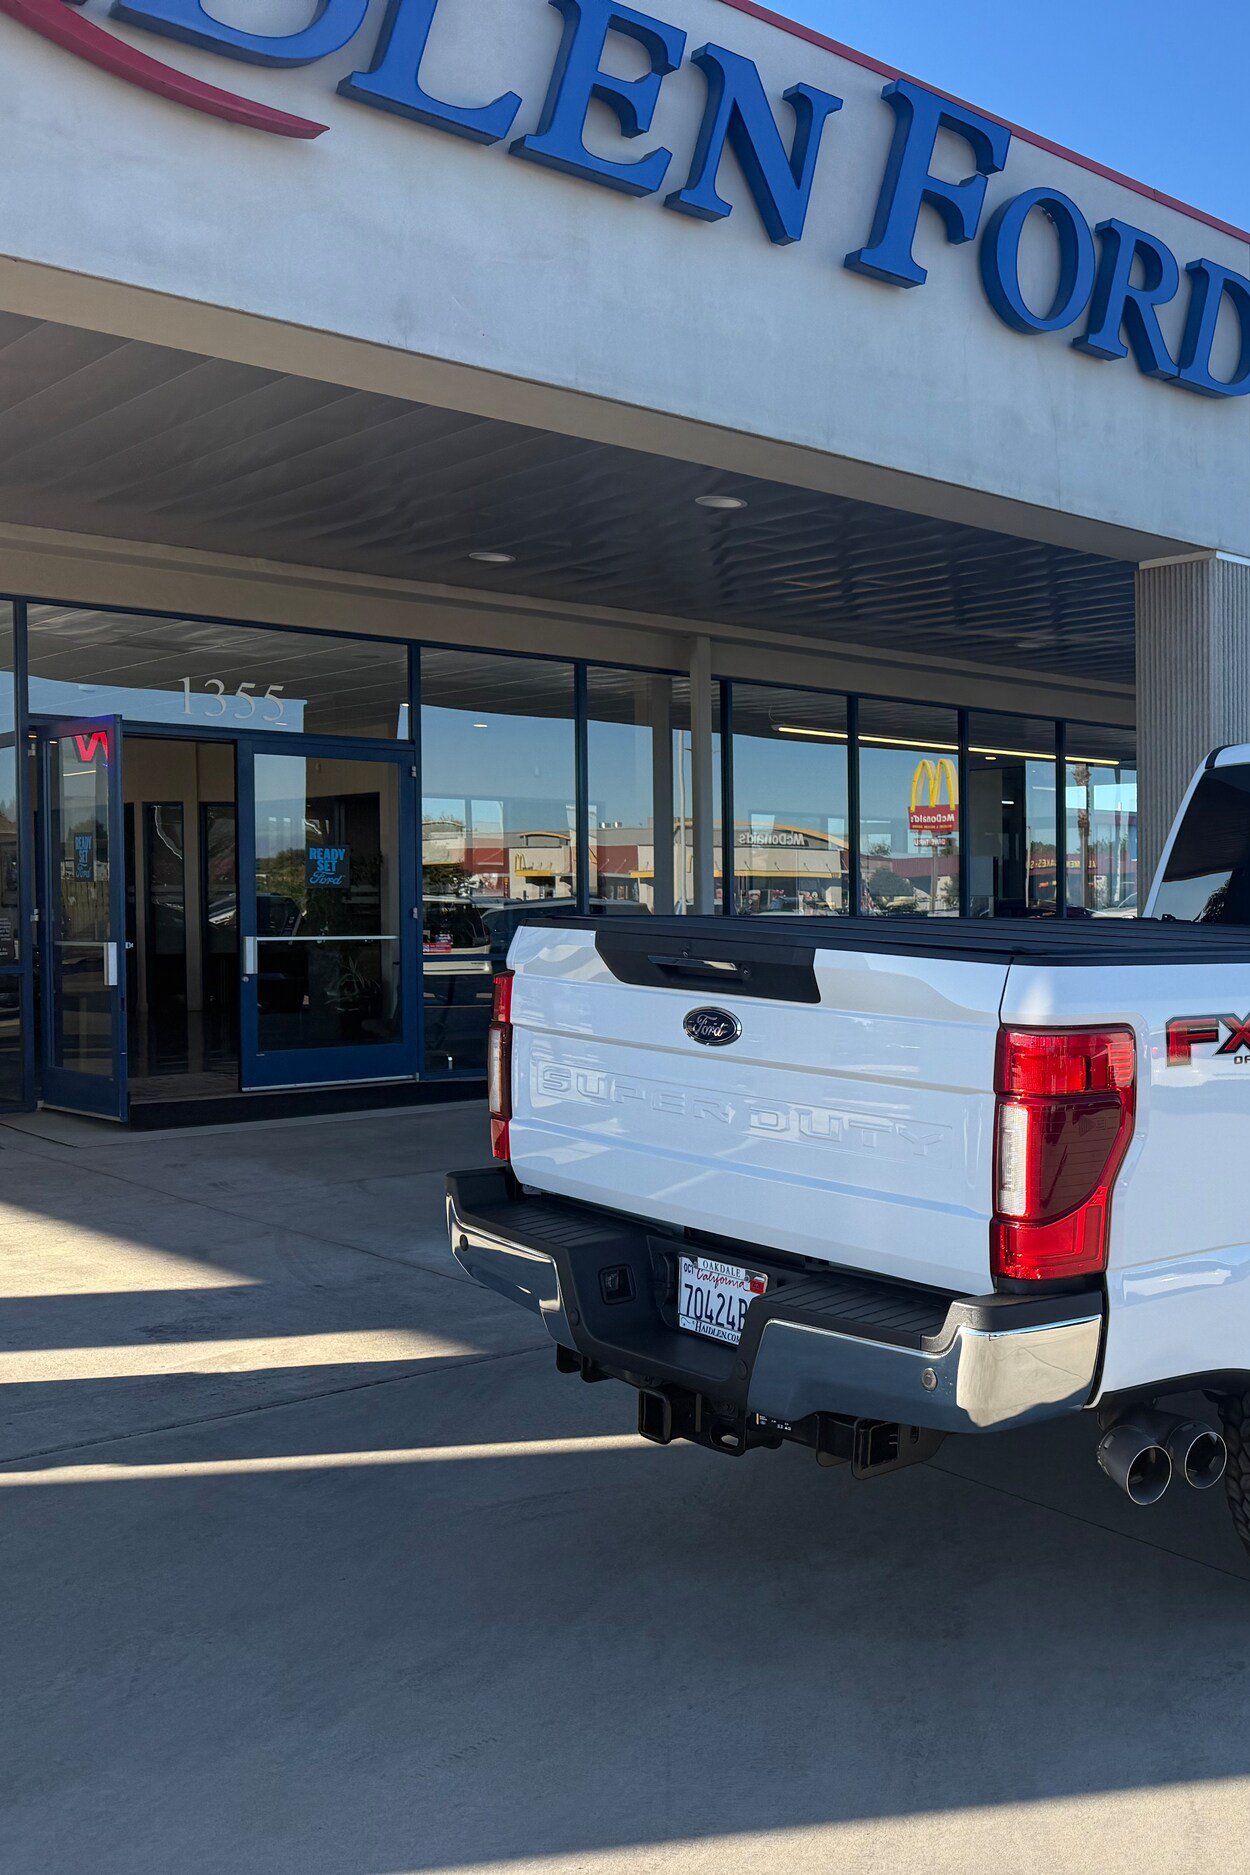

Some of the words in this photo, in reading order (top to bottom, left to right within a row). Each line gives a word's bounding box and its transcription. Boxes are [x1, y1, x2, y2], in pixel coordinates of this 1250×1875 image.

[177, 676, 285, 721] 1355
[309, 847, 346, 861] READY
[317, 860, 338, 872] SET
[309, 871, 345, 885] Ford
[541, 1066, 737, 1126] SUPER
[747, 1106, 945, 1158] DUTY
[683, 1262, 695, 1275] OCT
[702, 1260, 742, 1278] OAKDALE
[696, 1268, 745, 1289] California
